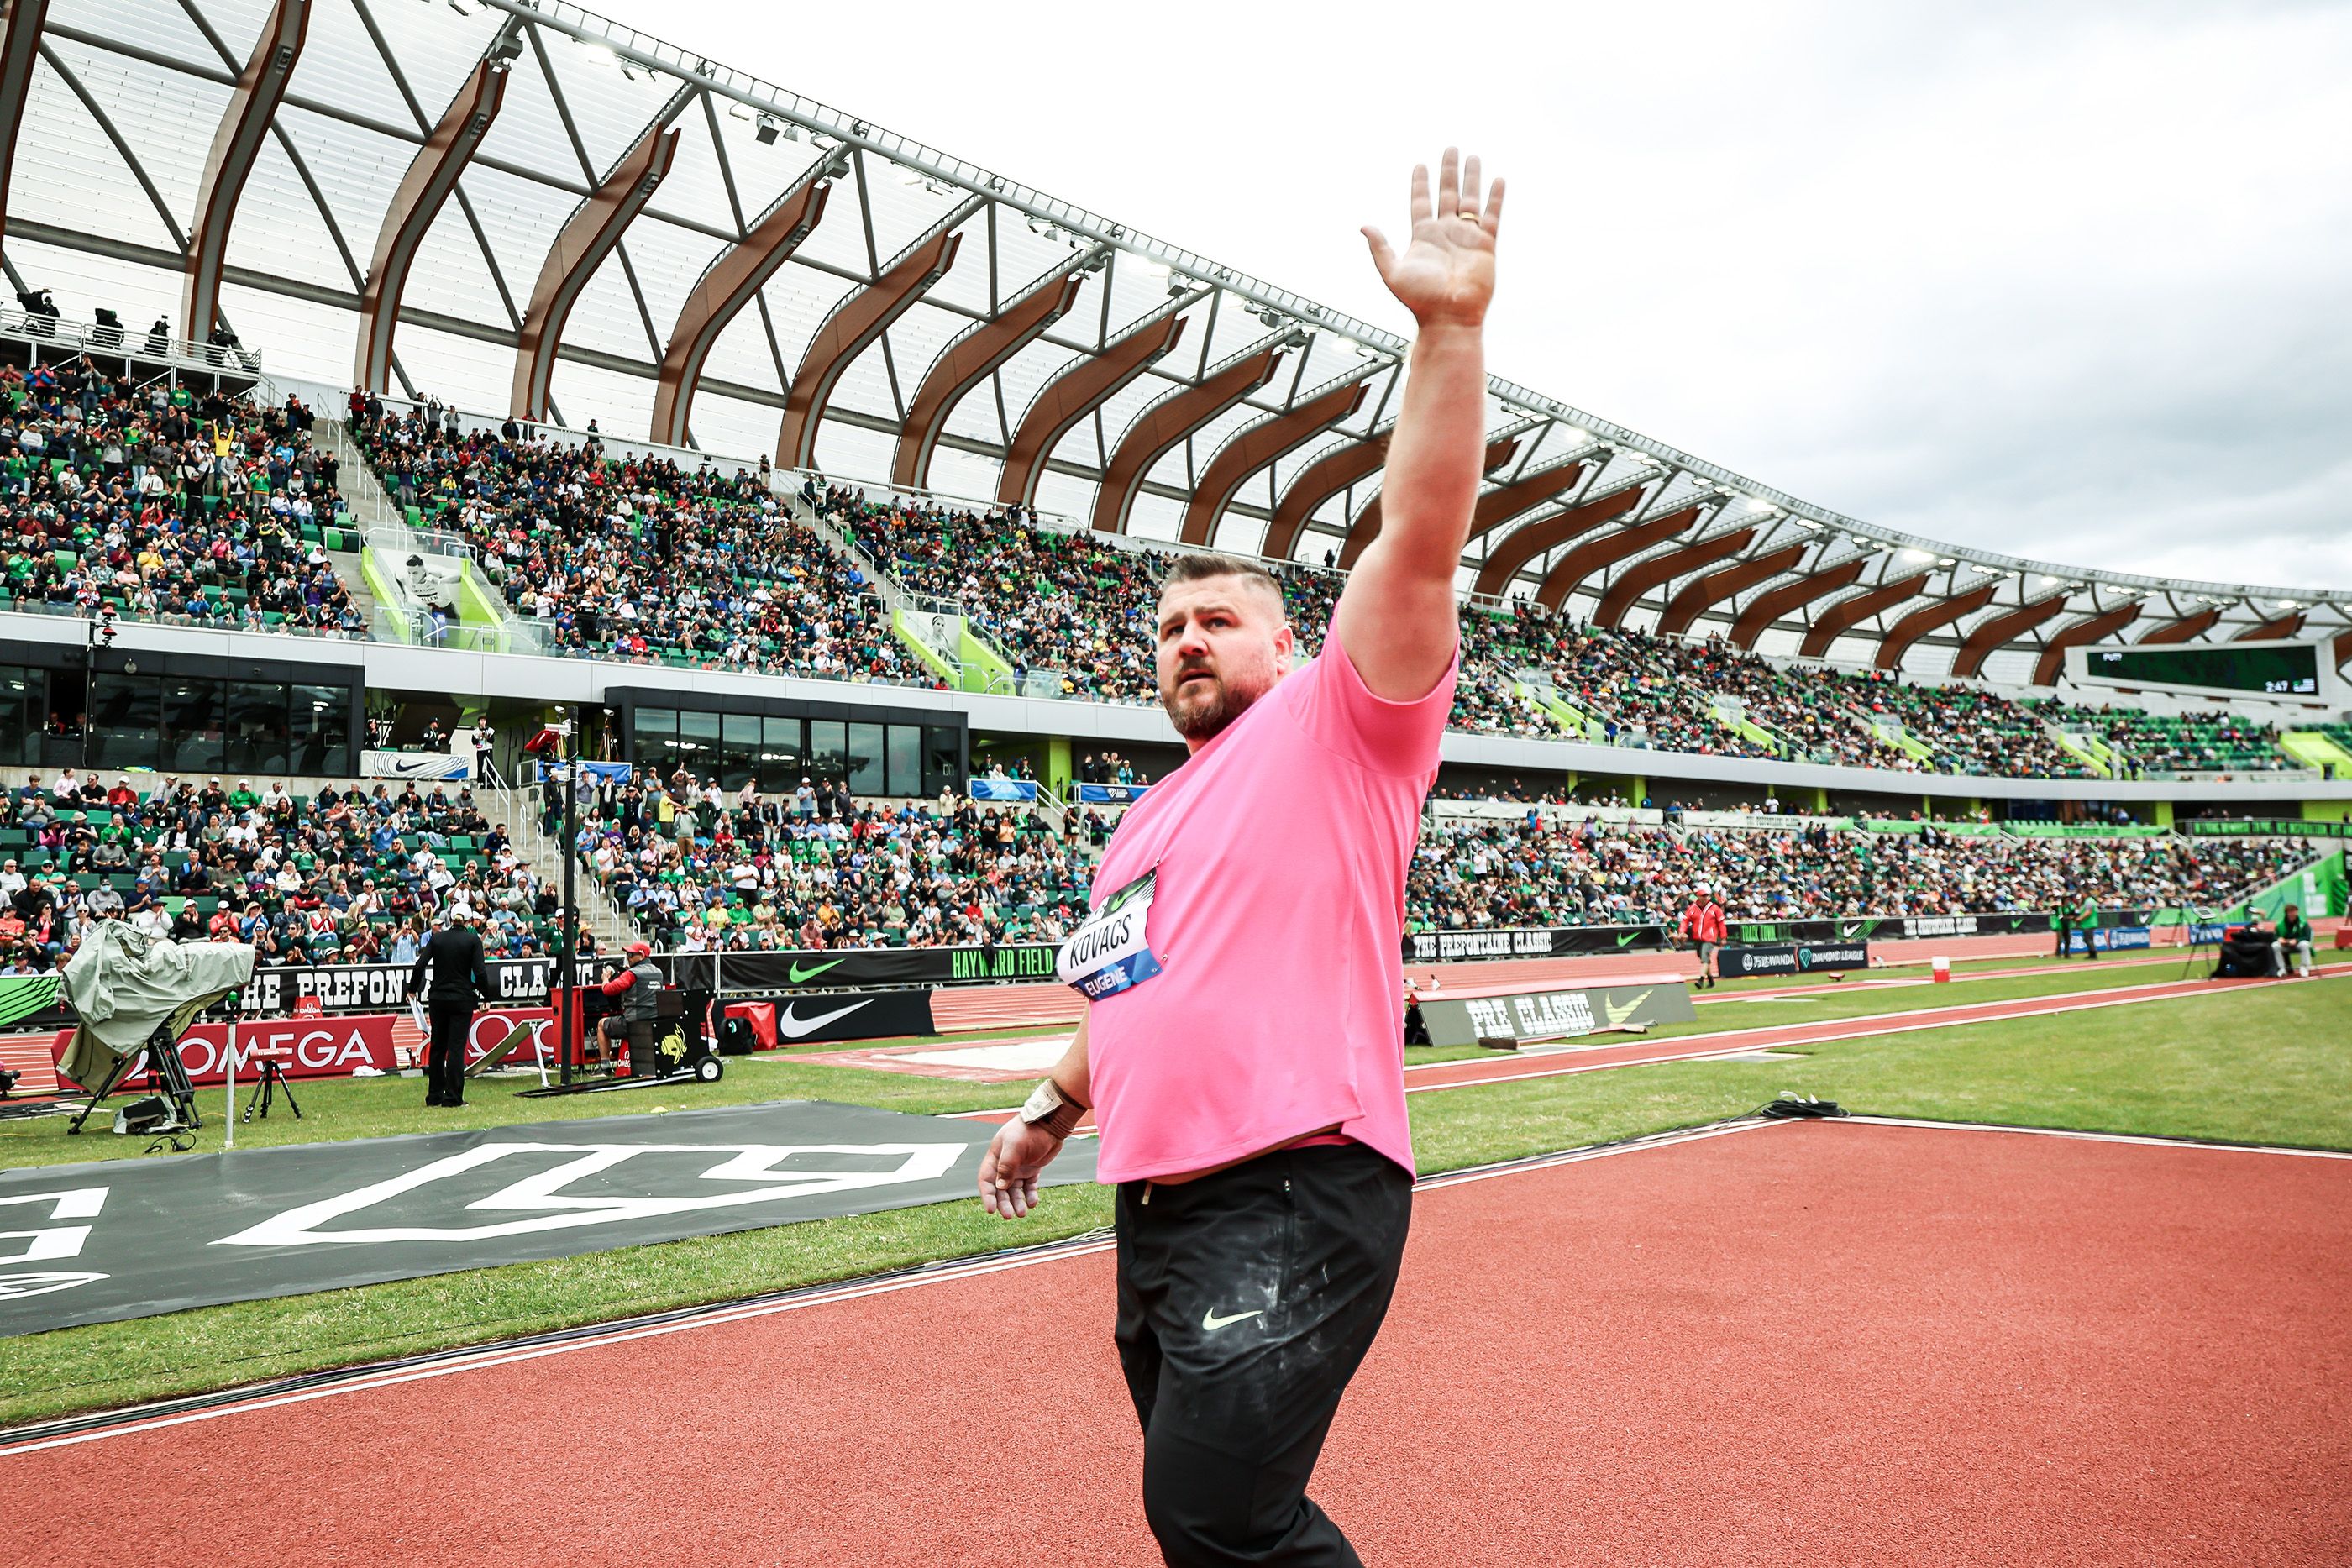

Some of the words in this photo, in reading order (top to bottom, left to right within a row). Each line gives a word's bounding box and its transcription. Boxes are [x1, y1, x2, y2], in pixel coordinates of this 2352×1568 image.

[1070, 914, 1131, 969] KOVACS
[1413, 935, 1436, 958] THE
[1439, 933, 1511, 957] PREFONTAINE
[1514, 931, 1553, 954] CLASSIC
[1019, 947, 1053, 975] FIELD
[1812, 952, 1840, 964] DIAMOND
[1841, 950, 1865, 962] LEAGUE
[1084, 966, 1128, 997] EUGENE
[1465, 998, 1515, 1039] PRE
[1514, 993, 1596, 1035] CLASSIC
[176, 1028, 375, 1077] OMEGA
[617, 1059, 632, 1068] OMEG
